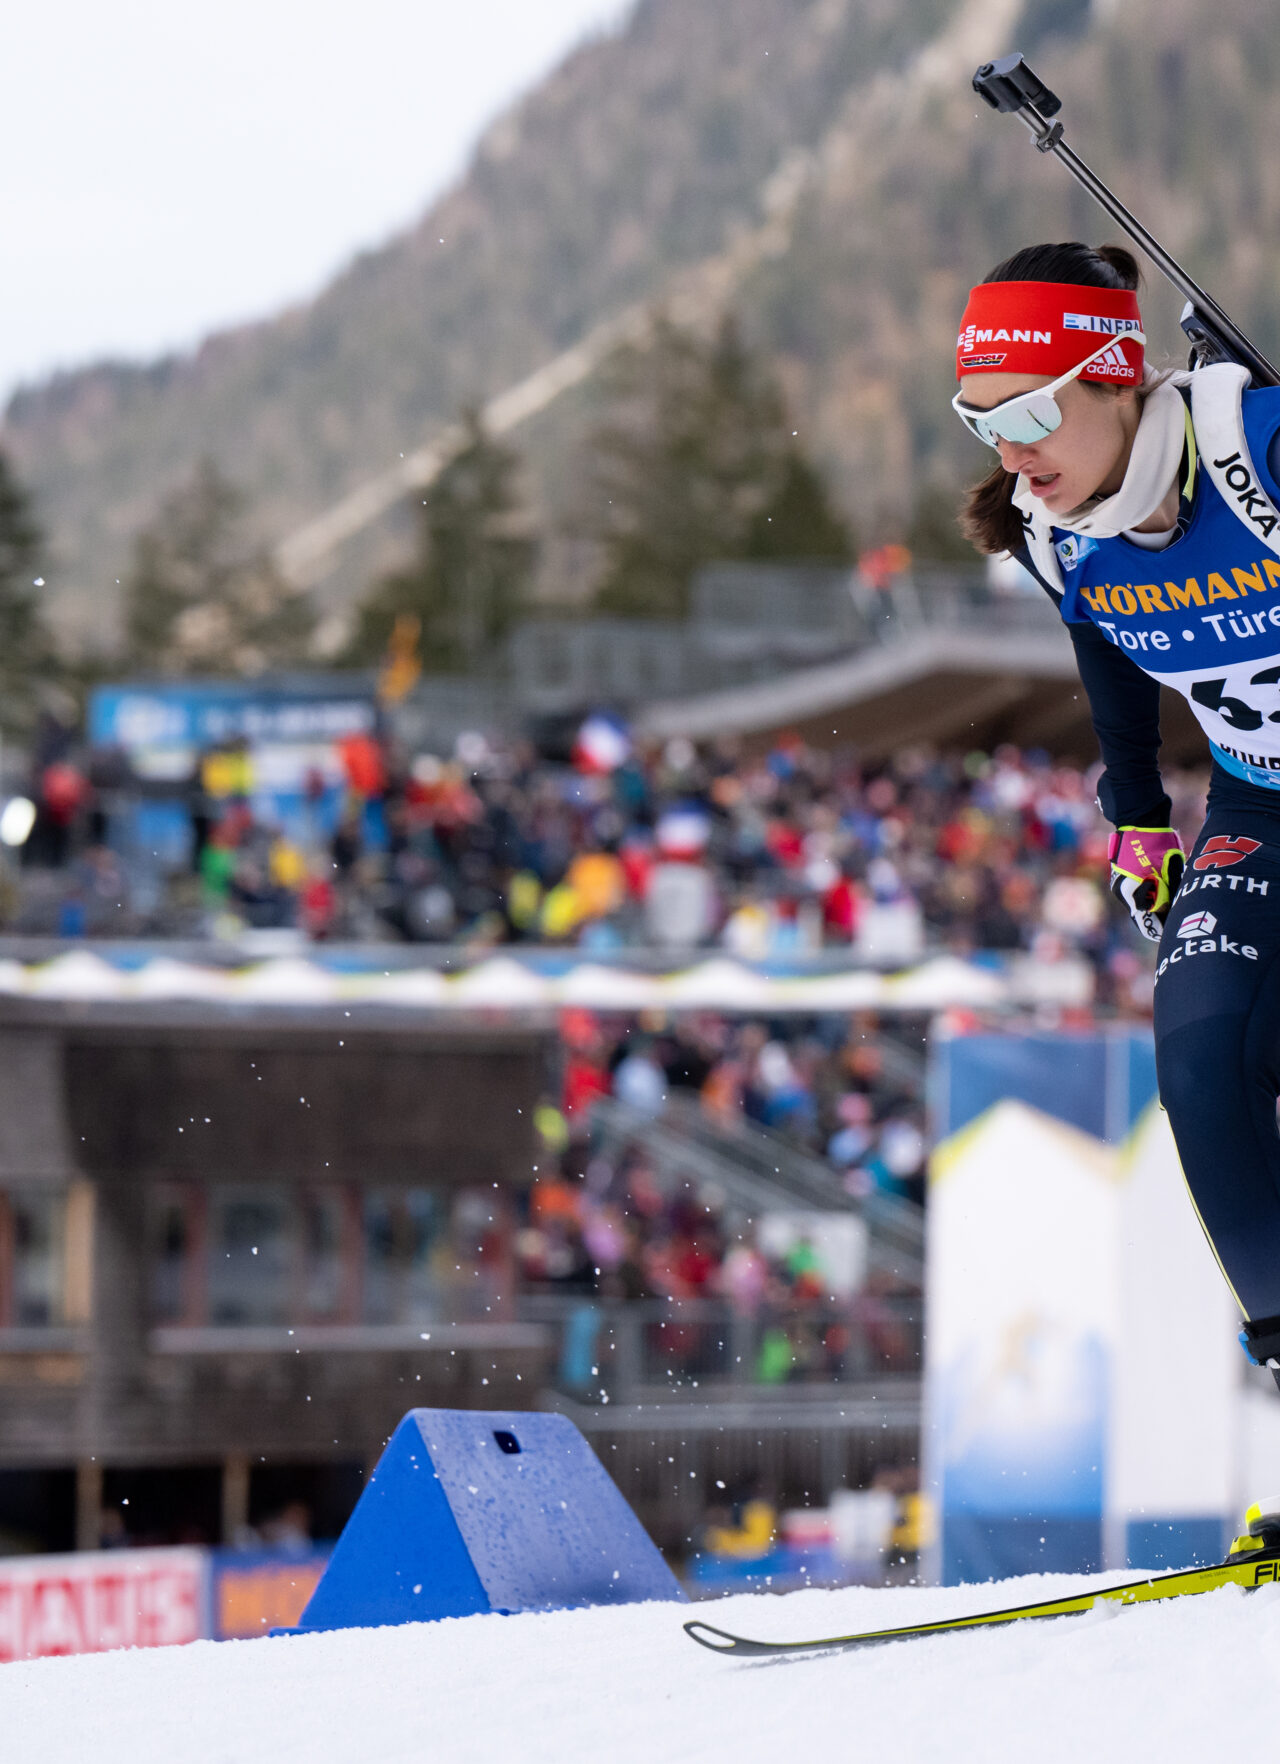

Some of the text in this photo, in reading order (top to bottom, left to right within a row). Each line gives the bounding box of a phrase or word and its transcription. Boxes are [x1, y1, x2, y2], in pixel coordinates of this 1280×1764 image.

[957, 325, 1052, 353] ESSMANN
[1086, 362, 1136, 379] adidas
[1213, 451, 1279, 539] JOKA
[1098, 620, 1172, 652] Tore
